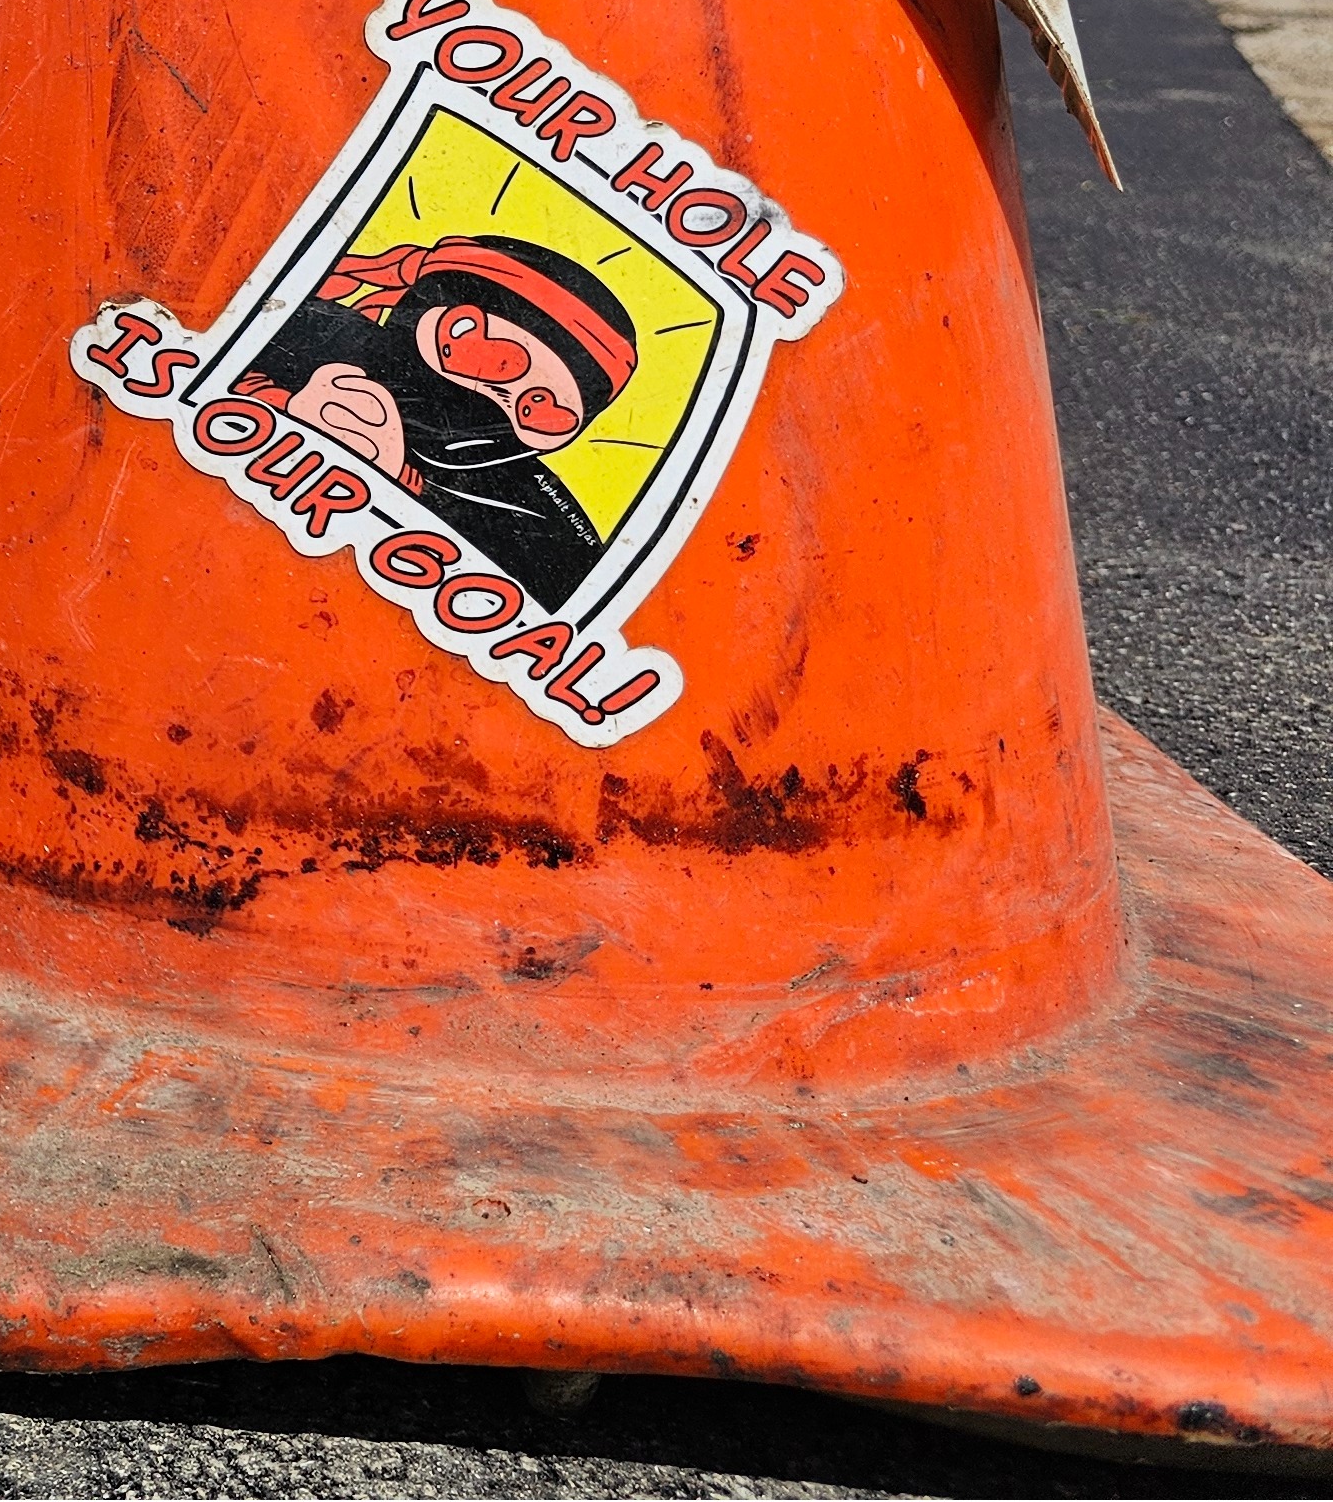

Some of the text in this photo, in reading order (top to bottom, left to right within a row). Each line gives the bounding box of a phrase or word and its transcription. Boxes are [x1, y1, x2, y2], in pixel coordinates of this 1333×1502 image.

[611, 142, 826, 319] HOLE
[86, 313, 661, 726] IS OUR GOAL!
[533, 473, 597, 547] Asphalt Ninjas
